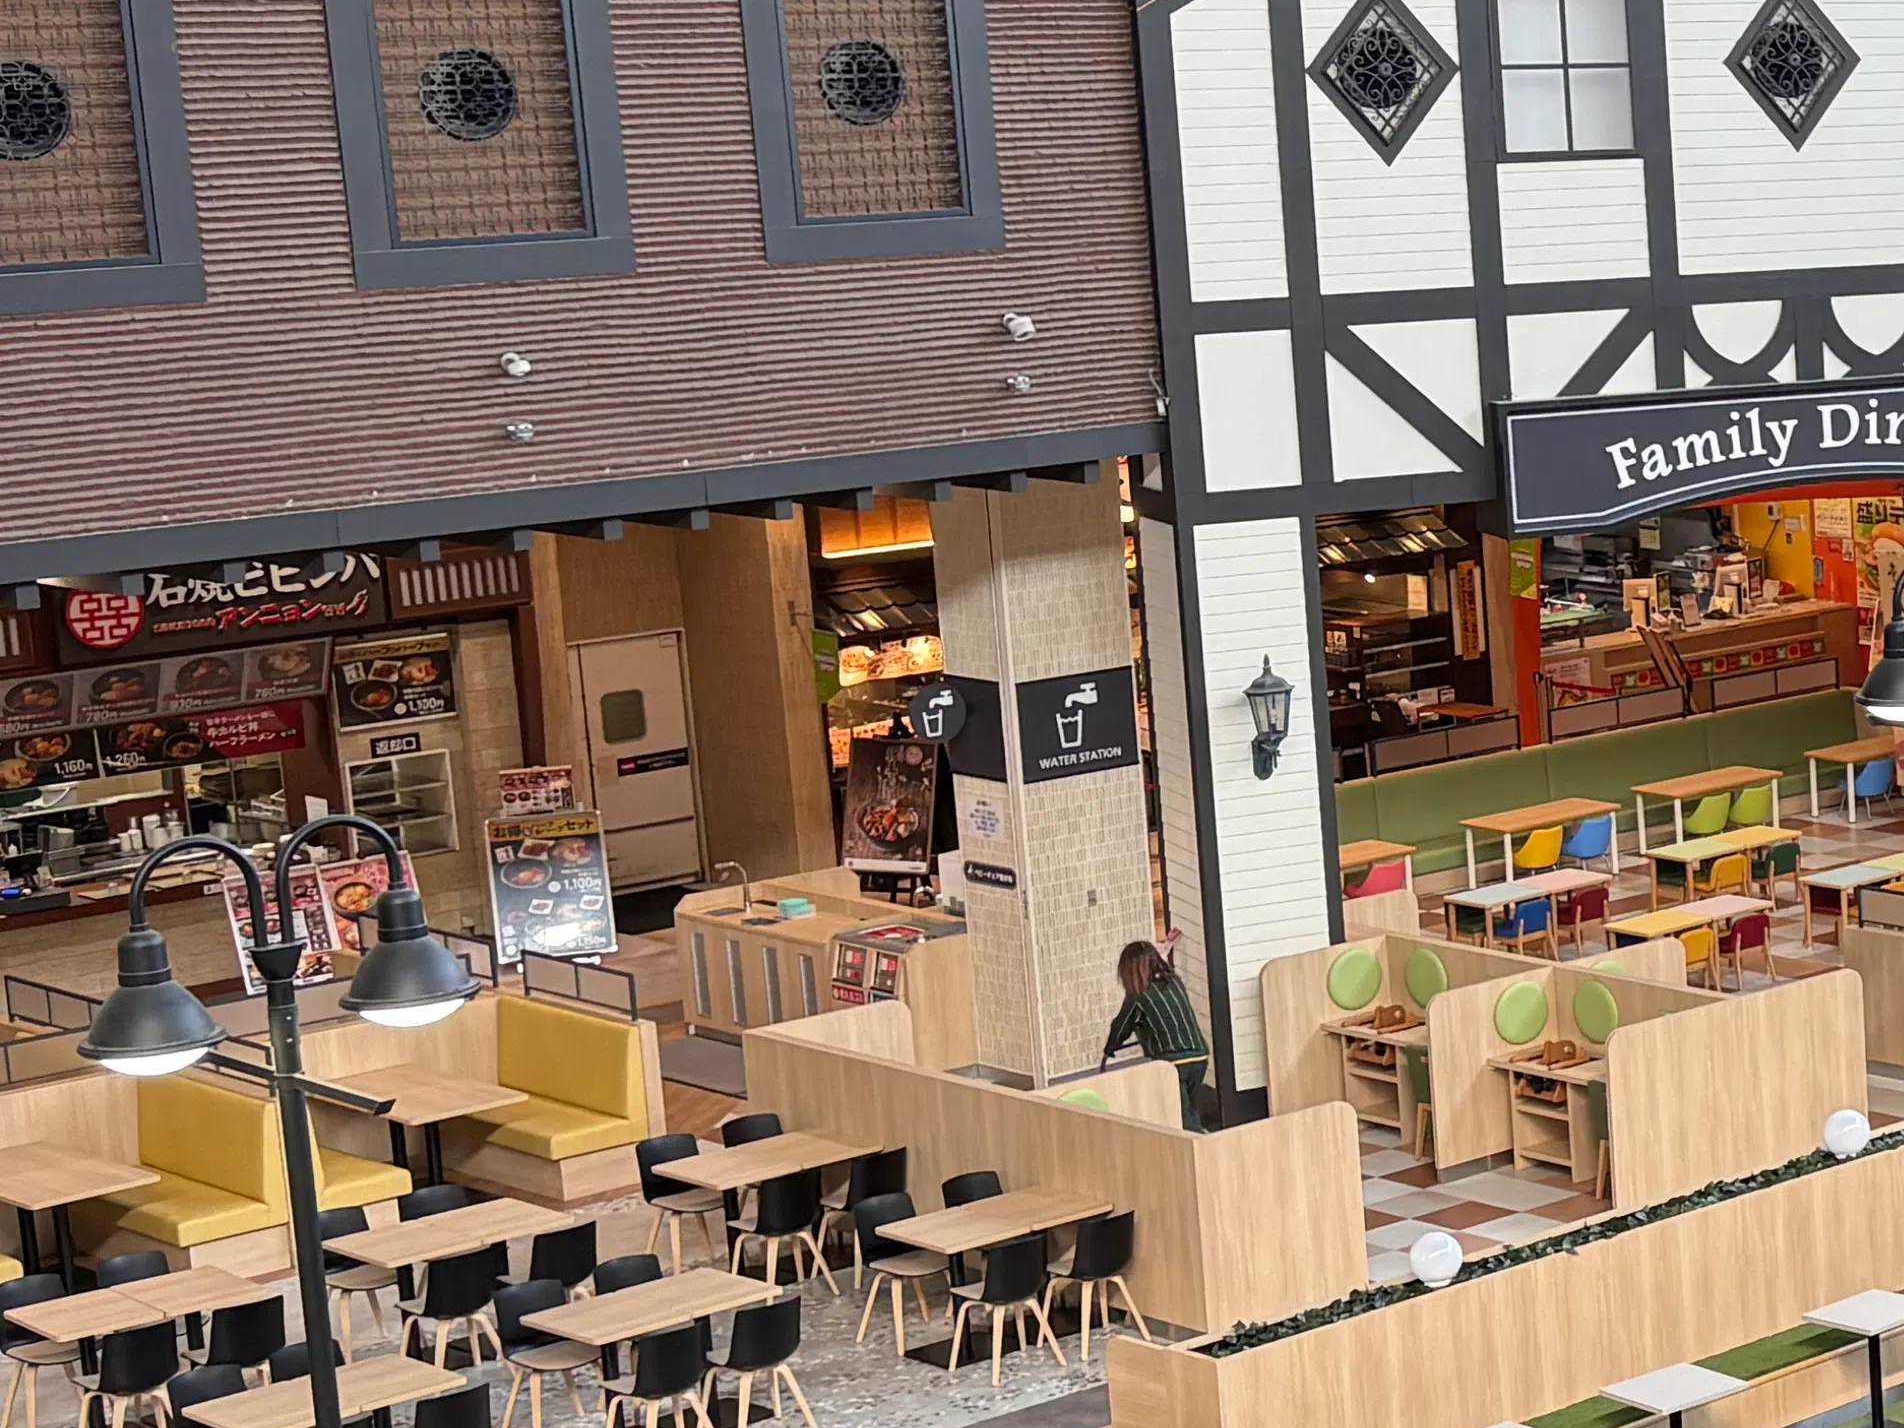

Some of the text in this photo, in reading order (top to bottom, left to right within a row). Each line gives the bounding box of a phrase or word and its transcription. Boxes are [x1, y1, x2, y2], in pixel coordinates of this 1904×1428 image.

[1606, 406, 1798, 489] Family
[1039, 746, 1122, 770] WATER STATION
